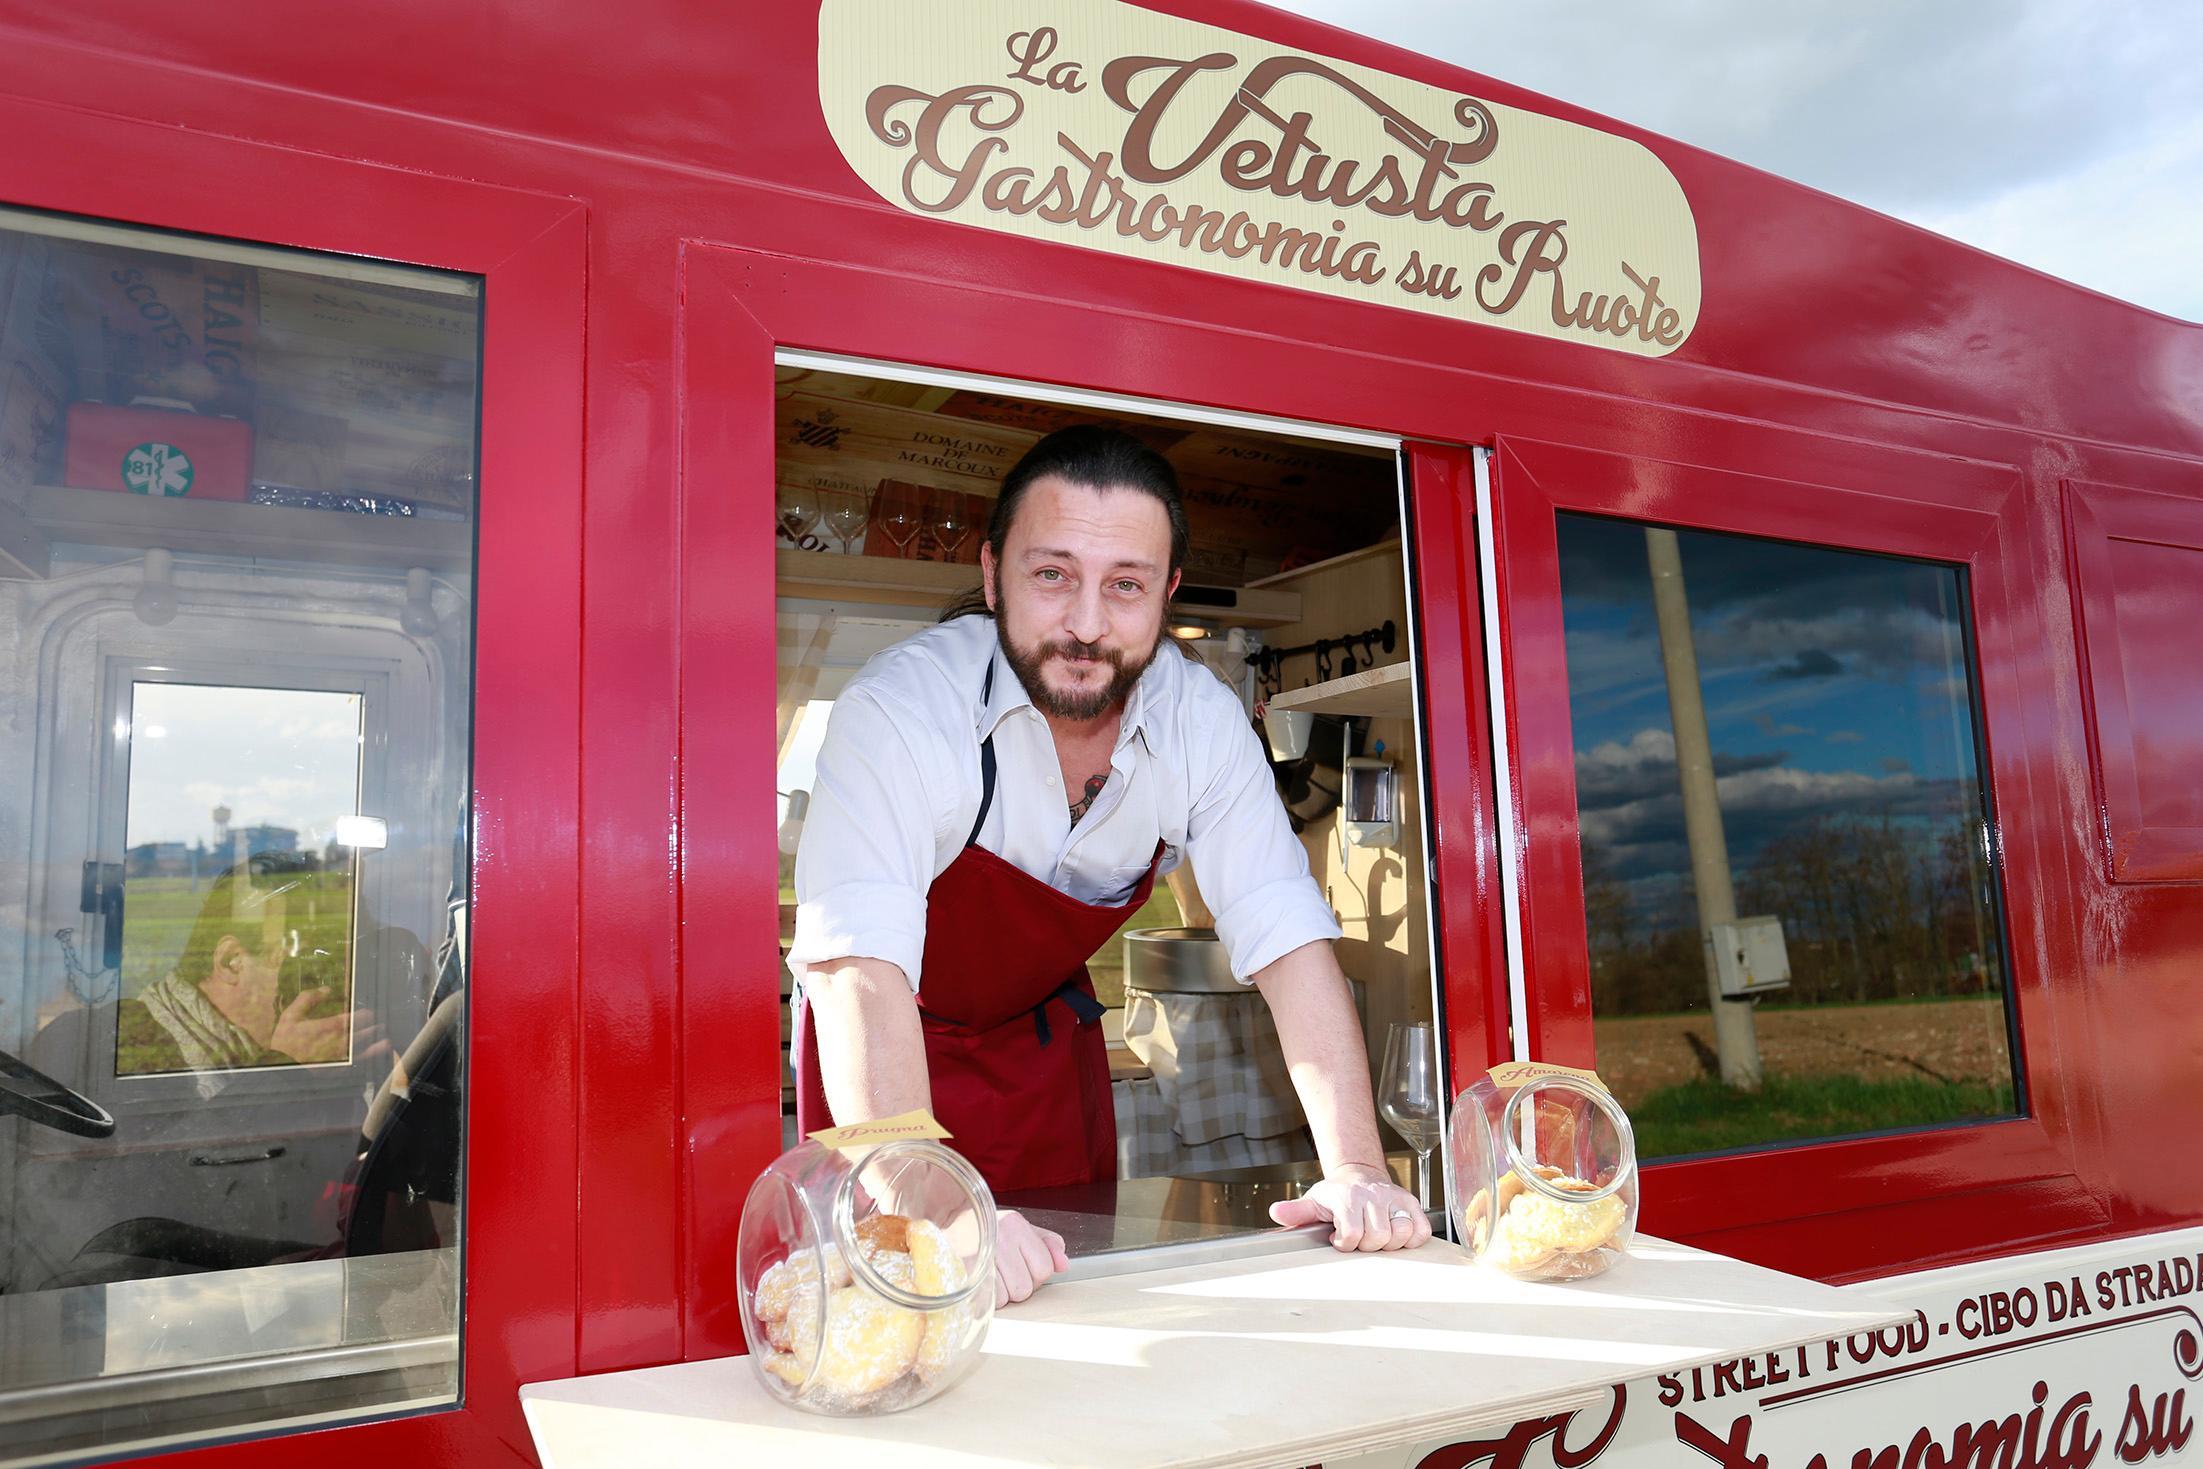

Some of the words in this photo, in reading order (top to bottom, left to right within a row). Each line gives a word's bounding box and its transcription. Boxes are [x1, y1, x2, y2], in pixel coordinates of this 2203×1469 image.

[1005, 26, 1088, 95] La
[1101, 52, 1504, 232] Vetusta
[865, 84, 1386, 284] Gastronomia
[1395, 250, 1463, 300] su
[1475, 219, 1684, 346] Ruote
[897, 450, 1001, 477] MARCOUX
[911, 431, 1009, 458] DOMAINE
[943, 448, 968, 461] DE
[837, 1124, 927, 1141] Prugna
[1955, 1286, 2038, 1340] CIBO
[2043, 1276, 2092, 1322] DA
[2113, 1383, 2194, 1465] su
